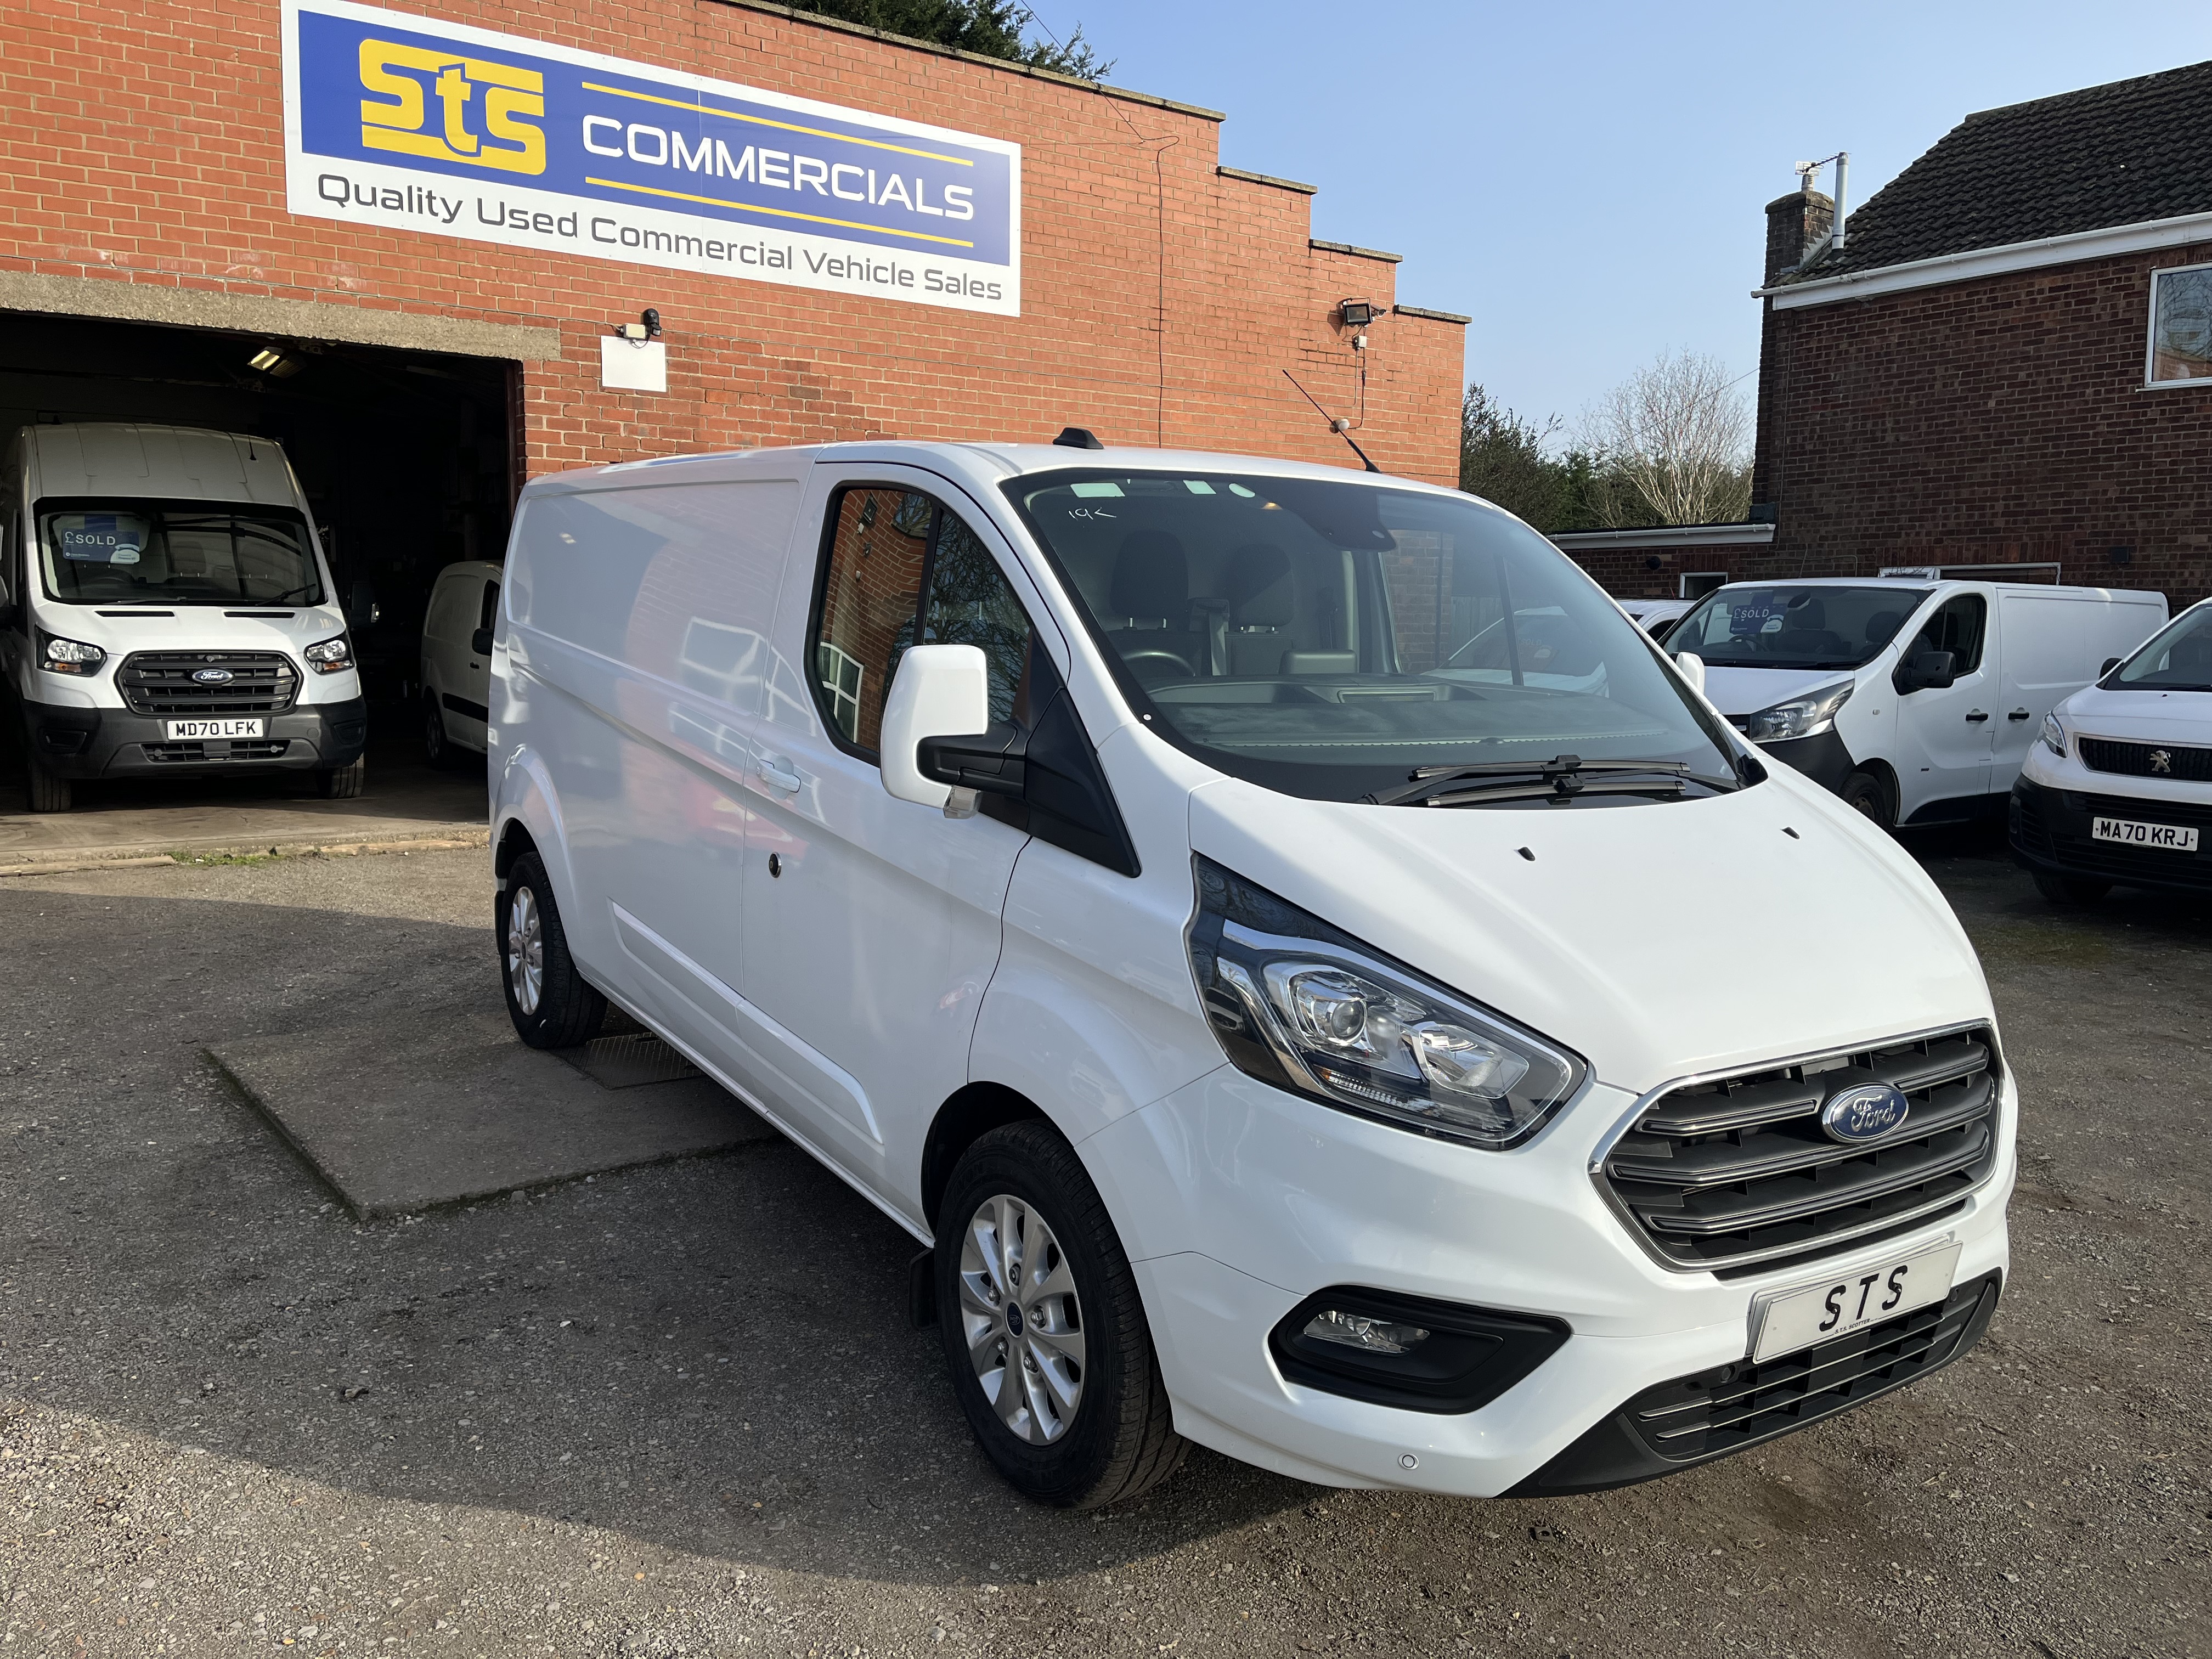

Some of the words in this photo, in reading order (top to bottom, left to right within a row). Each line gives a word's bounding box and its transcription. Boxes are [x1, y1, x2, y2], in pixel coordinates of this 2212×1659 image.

[582, 114, 975, 222] COMMERCIALS
[318, 173, 464, 224] Quality
[477, 197, 578, 239] Used
[590, 216, 792, 270] Commercial
[802, 249, 915, 288] Vehicle
[924, 268, 1002, 301] Sales
[200, 671, 224, 680] Ford
[175, 722, 219, 736] MD70
[224, 721, 256, 735] LFK
[2100, 820, 2146, 842] MA70
[2151, 827, 2189, 847] KRJ
[1850, 1094, 1896, 1132] Ford
[1848, 1318, 1870, 1330] SCOTTER
